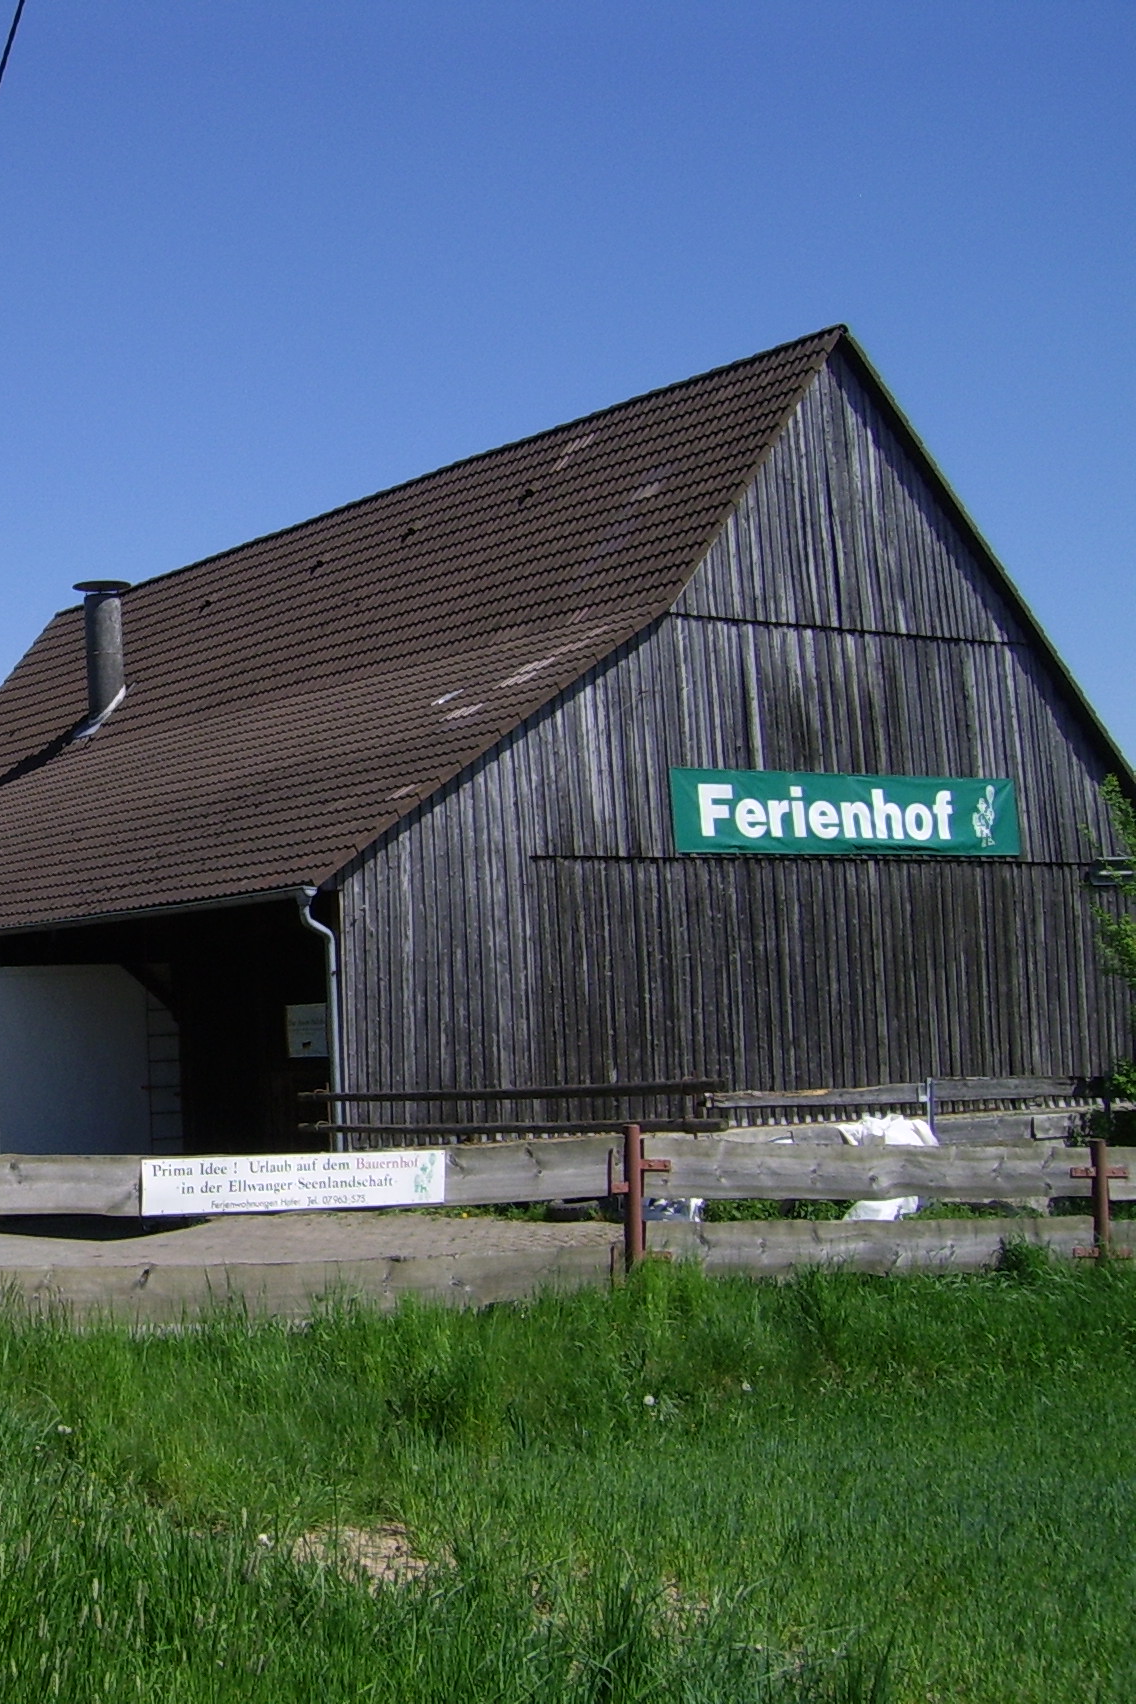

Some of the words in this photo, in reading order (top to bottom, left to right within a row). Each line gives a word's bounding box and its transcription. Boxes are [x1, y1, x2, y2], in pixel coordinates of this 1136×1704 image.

[697, 783, 954, 841] Ferienhof
[152, 1164, 193, 1177] Prima
[200, 1162, 228, 1175] Idee
[249, 1160, 292, 1174] Urlaub
[296, 1159, 318, 1172] auf
[322, 1157, 350, 1171] dem
[356, 1155, 420, 1170] Bauernhof
[181, 1181, 195, 1195] in
[200, 1181, 222, 1194] der
[228, 1179, 294, 1194] Ellwanger
[298, 1173, 393, 1189] Seenlandschaft
[211, 1199, 278, 1210] Ferienwohnungen
